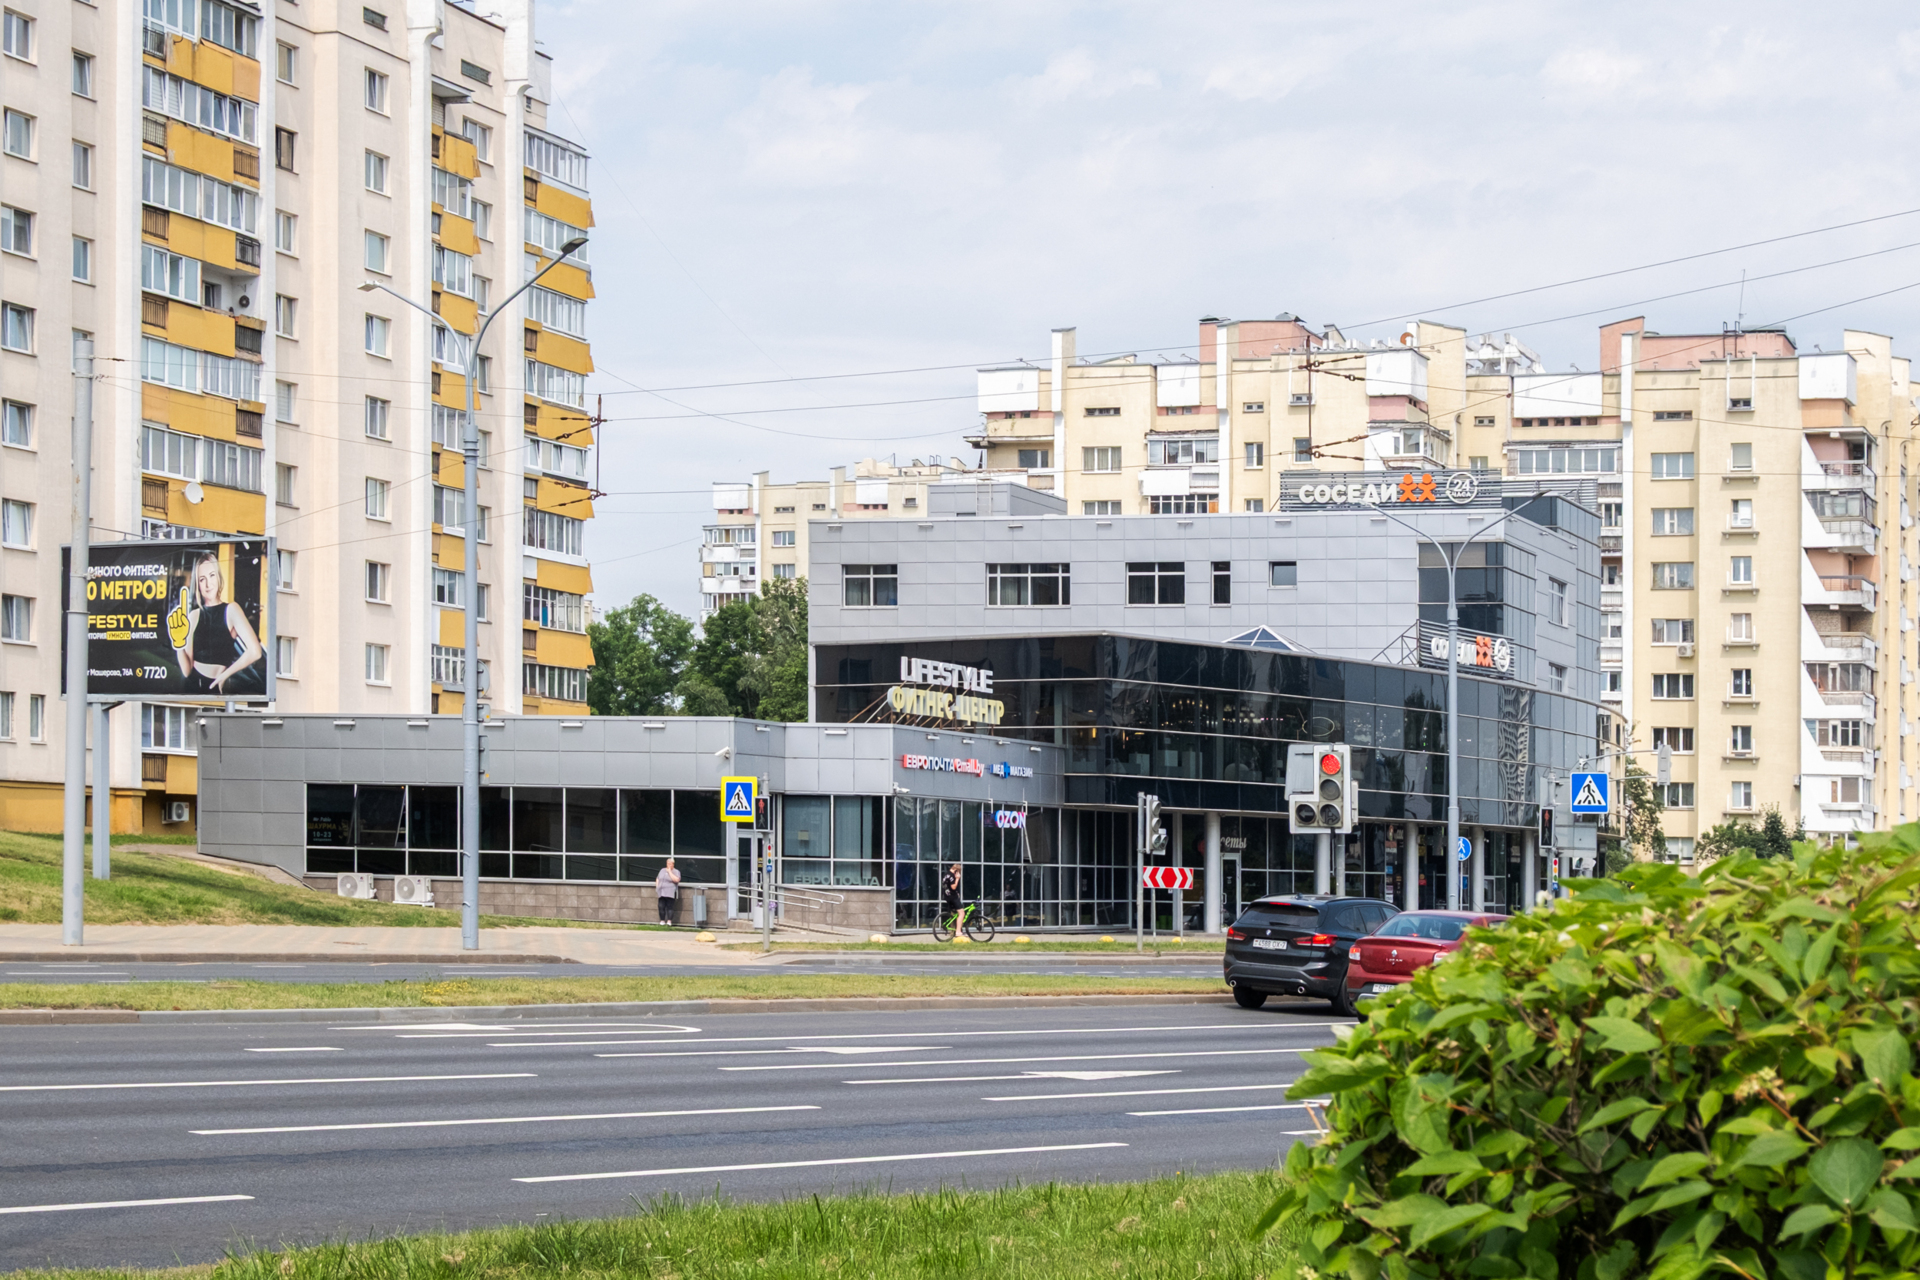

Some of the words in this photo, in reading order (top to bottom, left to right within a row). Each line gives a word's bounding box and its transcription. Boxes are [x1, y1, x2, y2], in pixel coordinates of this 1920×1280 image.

[1299, 483, 1397, 503] СОСЕДИ
[1453, 479, 1471, 492] 24
[123, 565, 168, 576] ФИТНЕСА:
[87, 581, 97, 601] 0
[101, 580, 167, 600] МЕТРОВ
[88, 614, 158, 628] FESTYLE
[1431, 637, 1476, 665] СОЕДИ
[143, 666, 168, 679] 7720
[900, 656, 994, 694] LIFESTYLE
[887, 685, 1005, 726] ФИТНЕС-ЦЕНТР
[904, 754, 955, 772] ЕВРОПОЧТА
[995, 810, 1026, 829] OZON
[793, 874, 880, 887] ЕВРОПОЧТА
